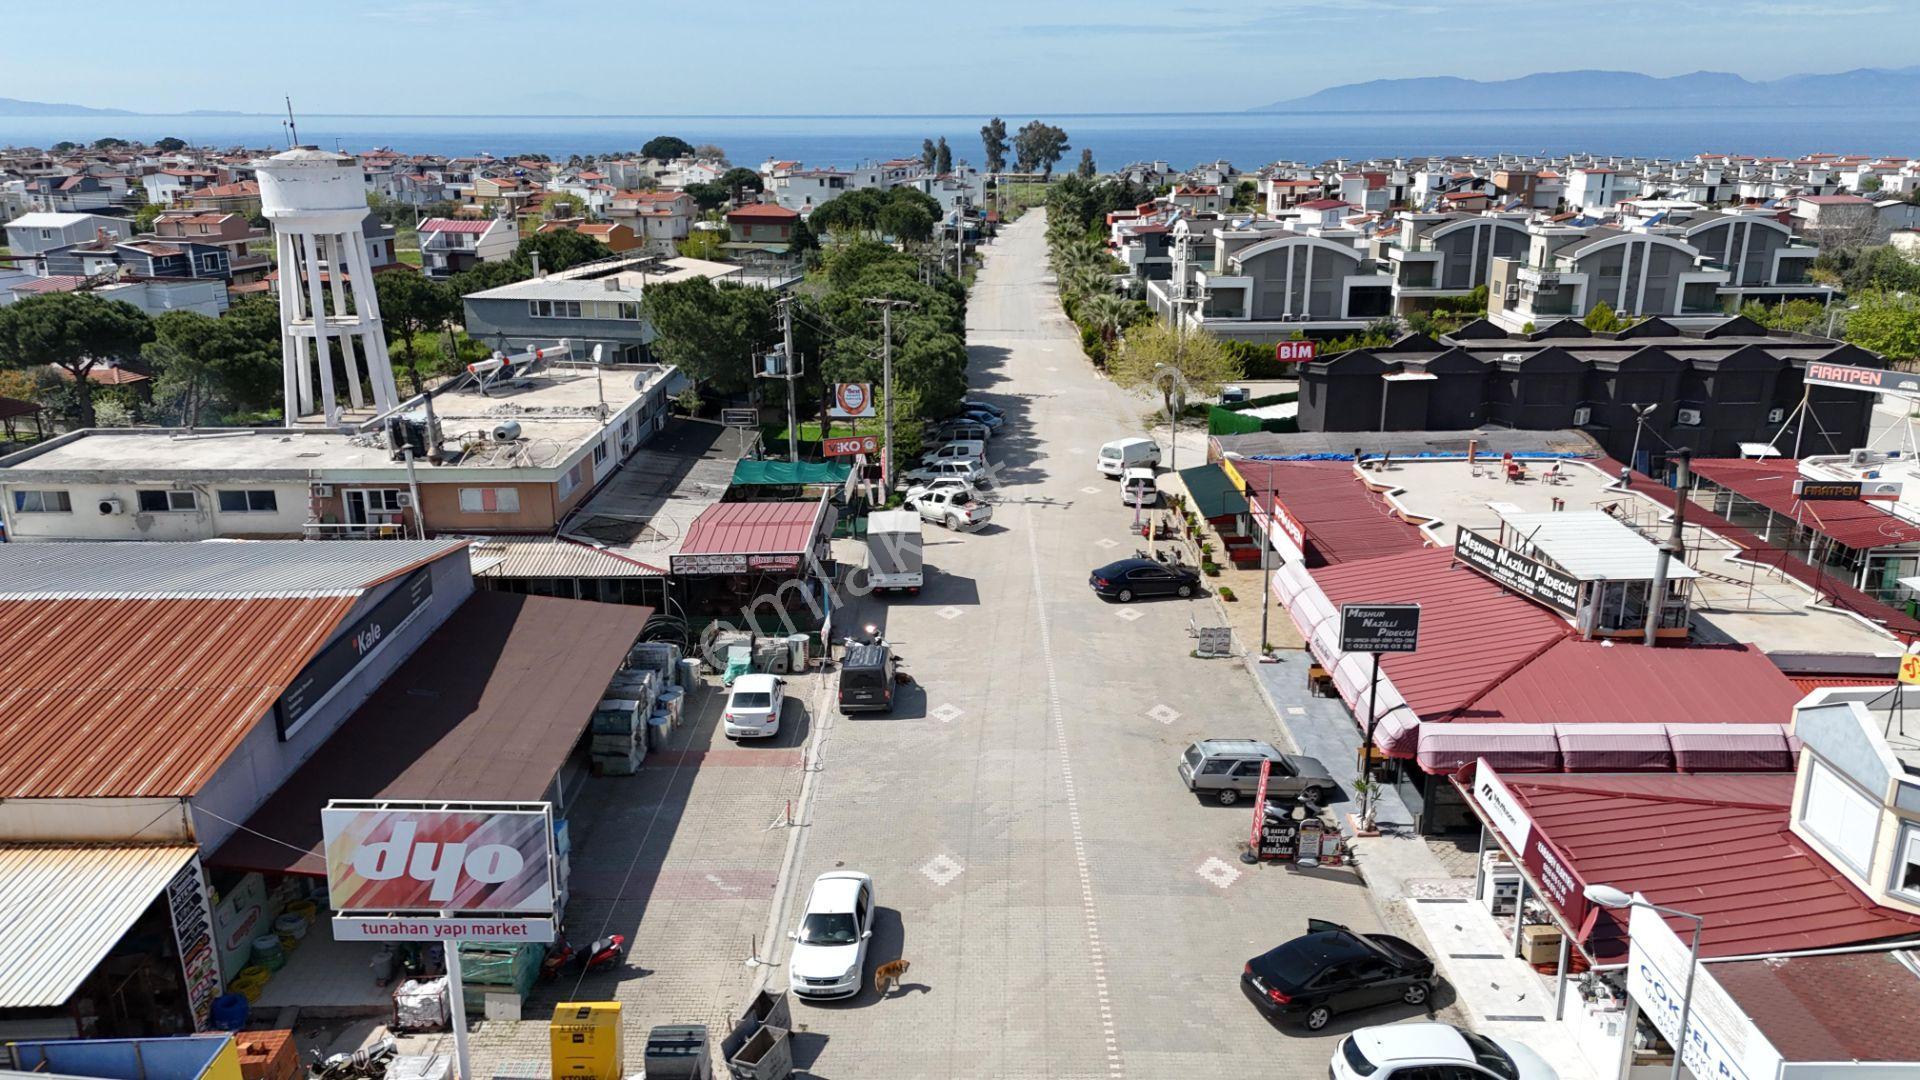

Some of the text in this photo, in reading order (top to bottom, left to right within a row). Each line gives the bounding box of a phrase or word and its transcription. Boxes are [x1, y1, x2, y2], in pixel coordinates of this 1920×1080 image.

[1809, 365, 1882, 385] FIRATPEN
[1803, 485, 1859, 496] FIRATPEN
[1347, 608, 1386, 618] MEŞHUR
[356, 622, 382, 656] Kale
[352, 821, 525, 902] dyo
[361, 922, 529, 938] tunahan yapı market
